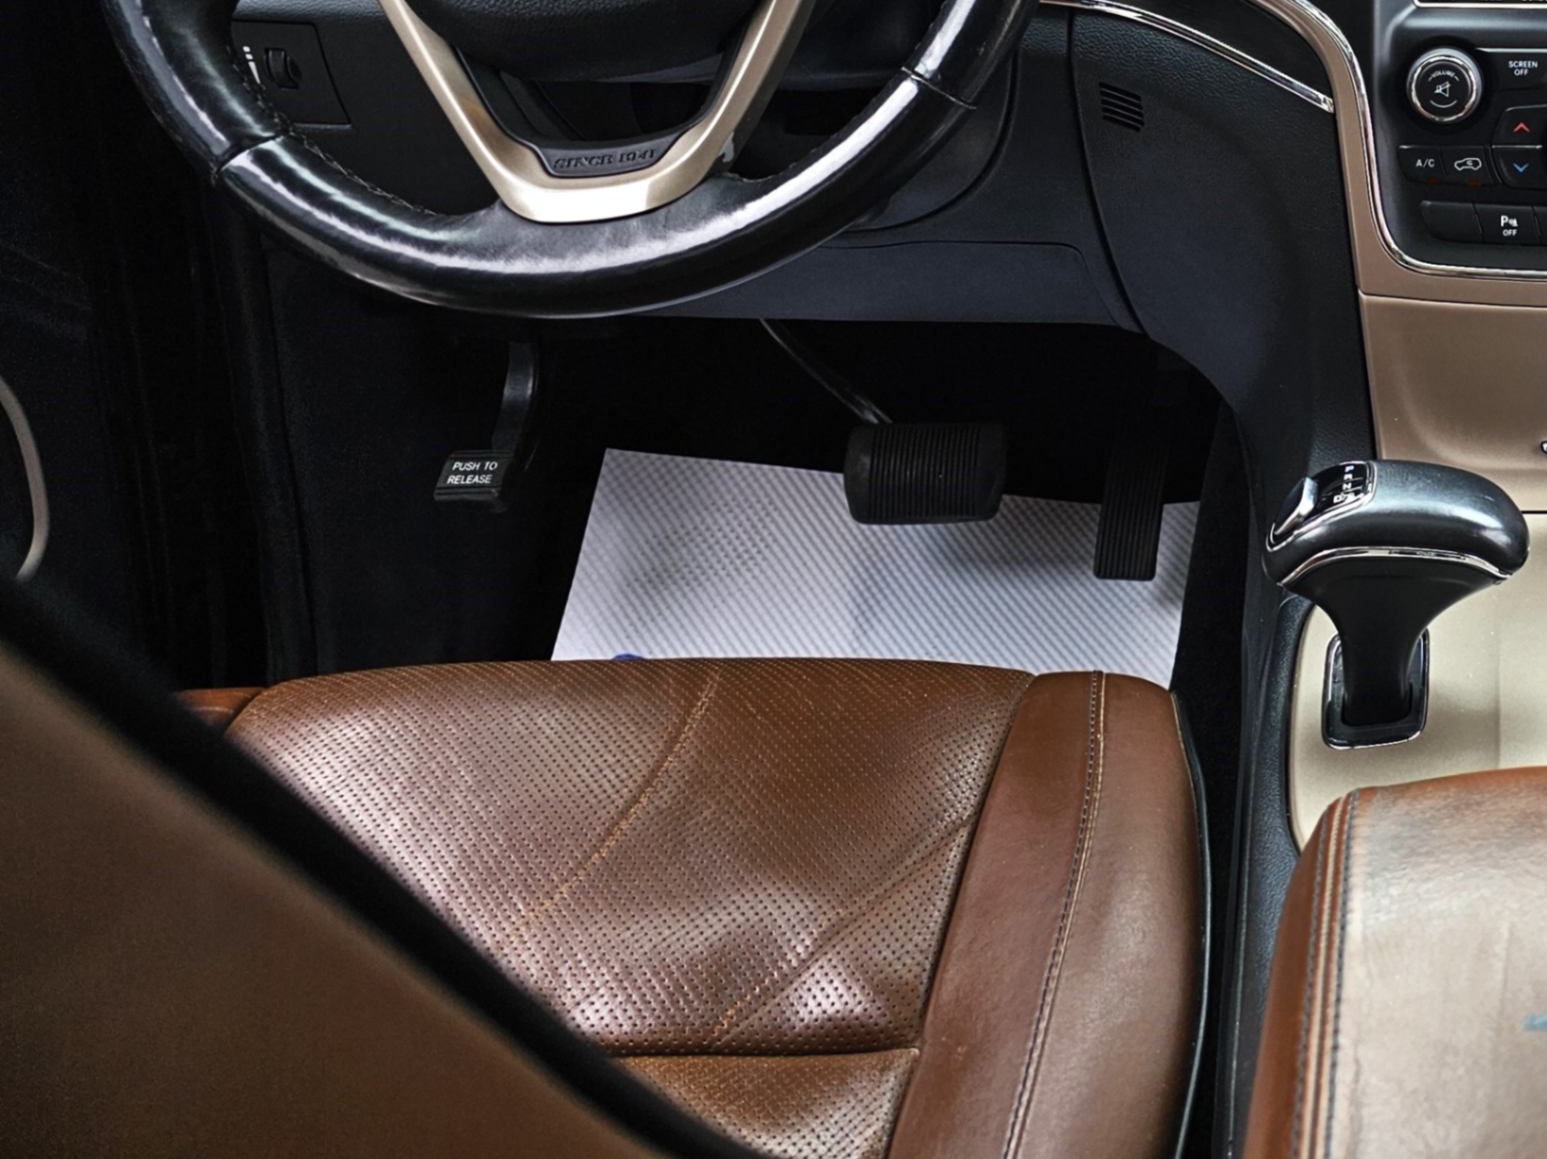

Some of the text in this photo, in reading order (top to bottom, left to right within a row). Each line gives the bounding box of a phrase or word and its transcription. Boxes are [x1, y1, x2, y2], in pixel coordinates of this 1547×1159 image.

[1508, 61, 1538, 69] SCREEN
[1514, 68, 1528, 76] OFF
[1416, 159, 1435, 168] A/C
[1502, 229, 1517, 237] OFF
[452, 461, 498, 471] PUSH TO
[446, 474, 493, 485] RELEASE
